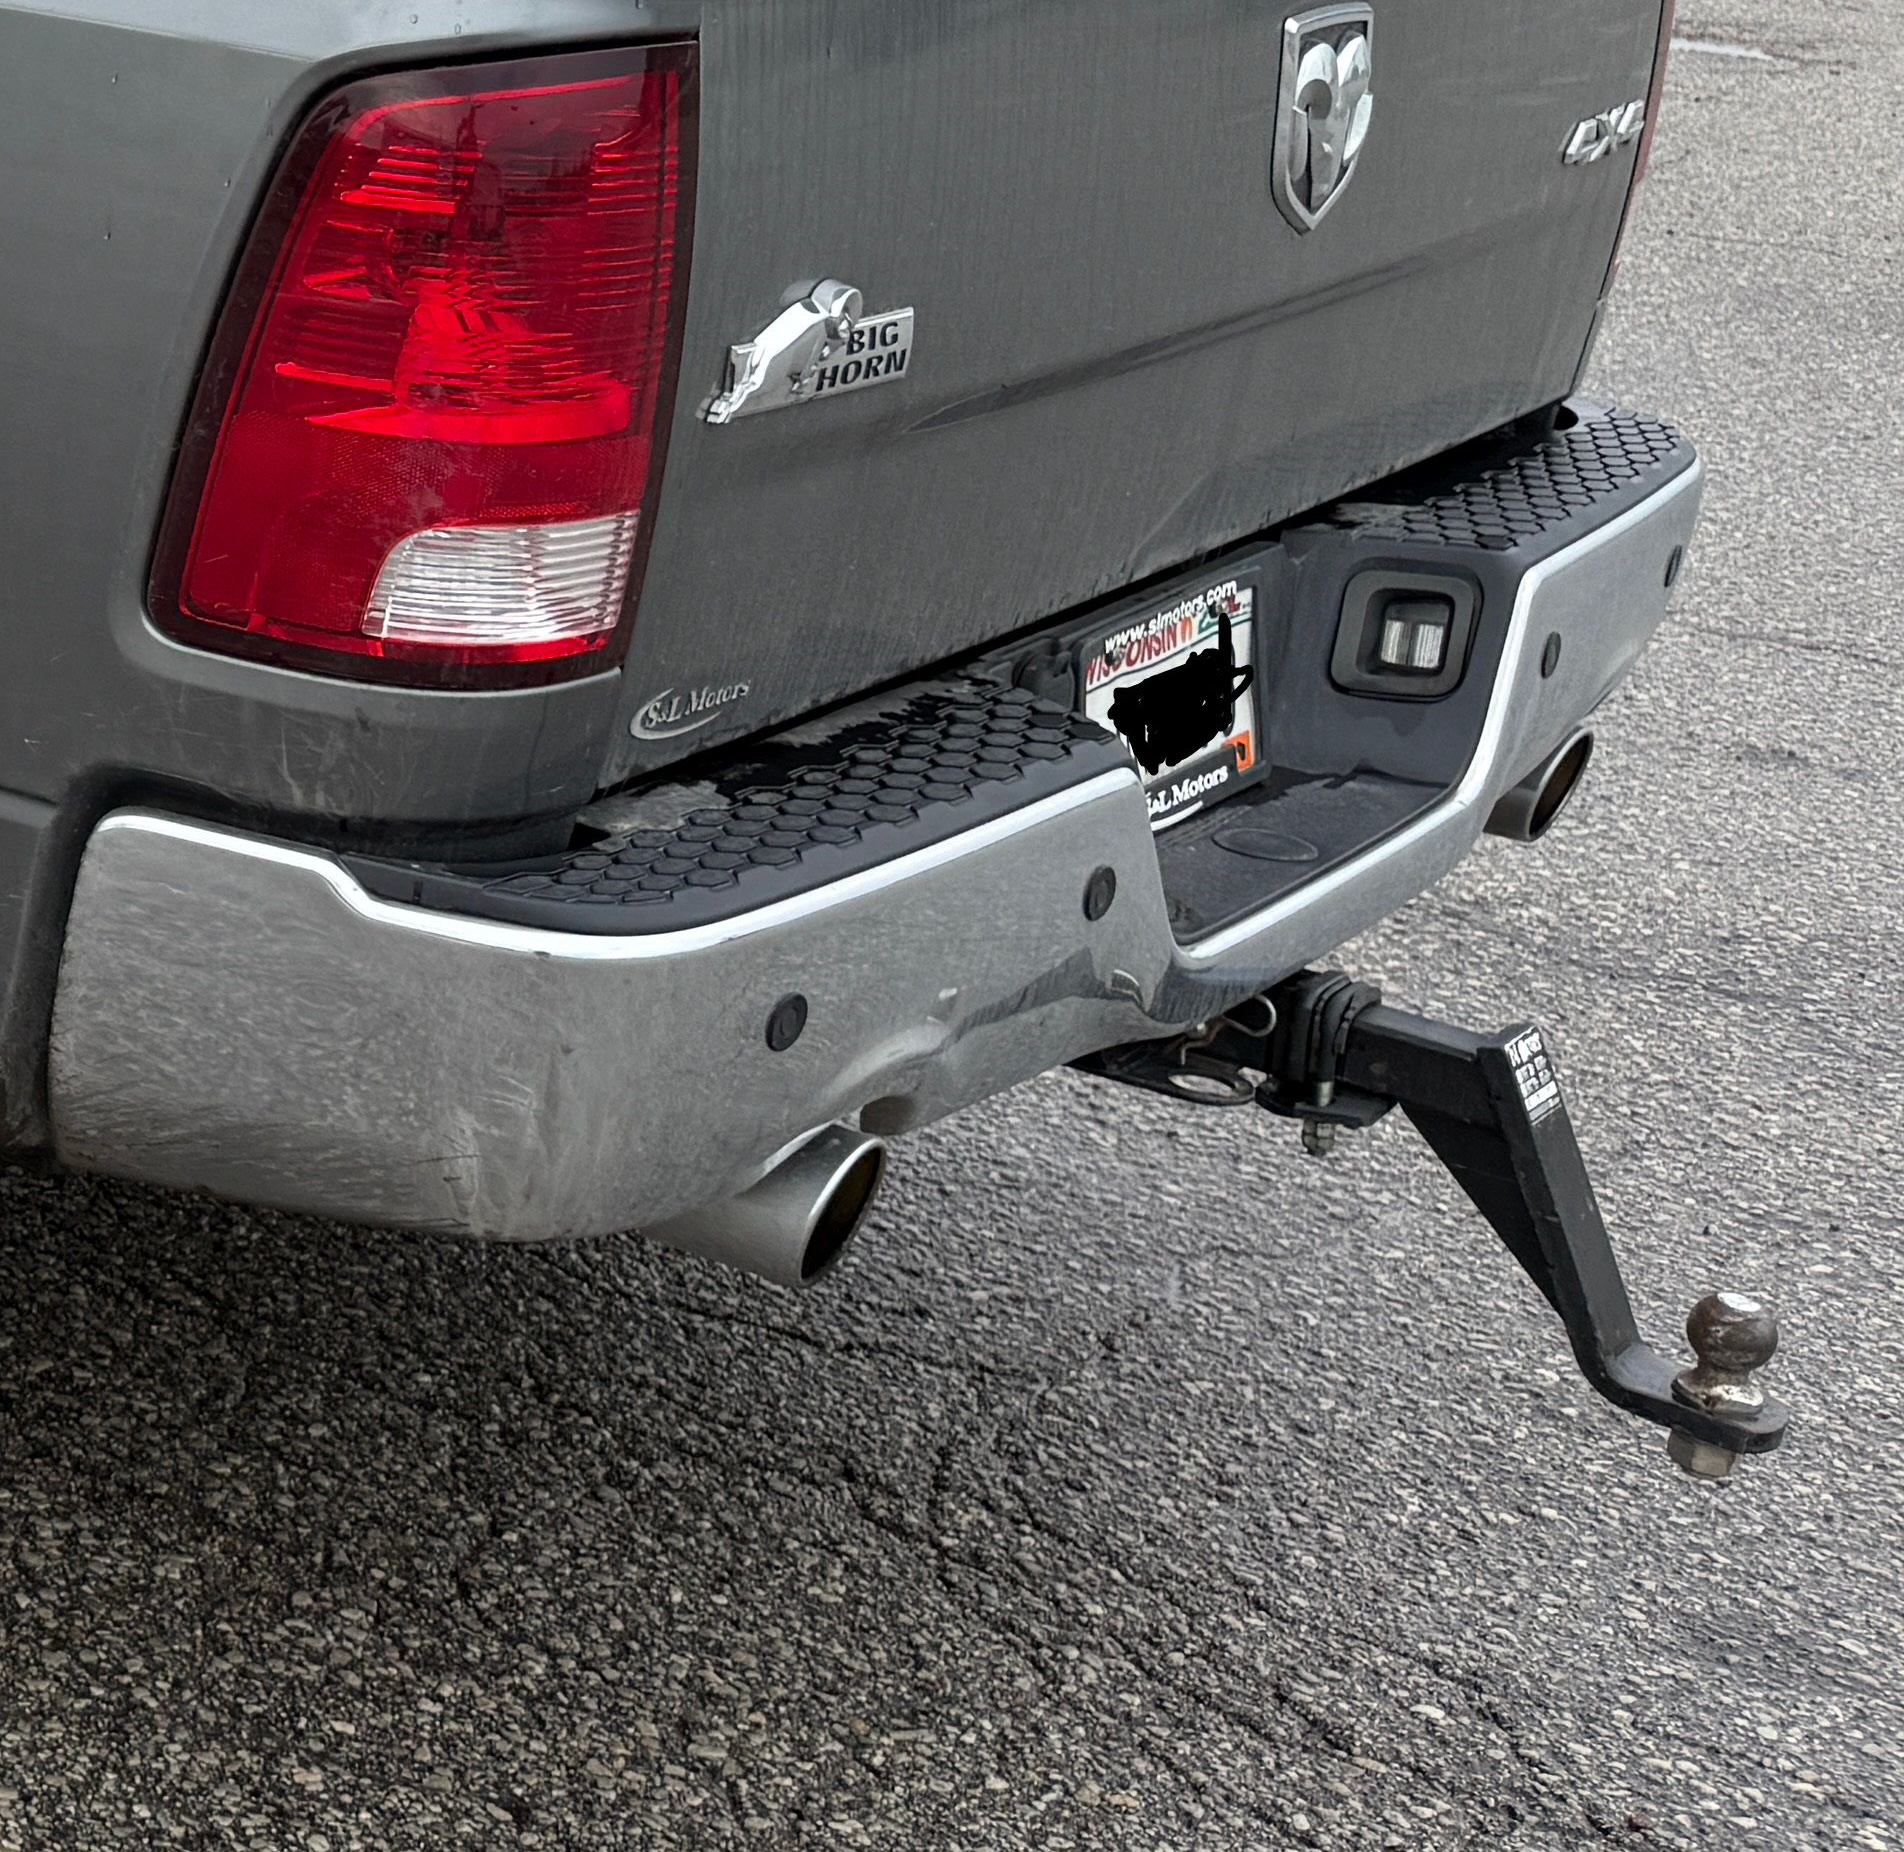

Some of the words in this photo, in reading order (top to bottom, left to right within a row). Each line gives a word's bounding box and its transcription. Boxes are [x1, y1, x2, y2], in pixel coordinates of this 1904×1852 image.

[845, 321, 898, 356] BIG
[815, 349, 907, 392] HORN
[1105, 580, 1238, 654] www.slmotors.com
[684, 679, 751, 716] Motors
[1171, 765, 1228, 806] Motors
